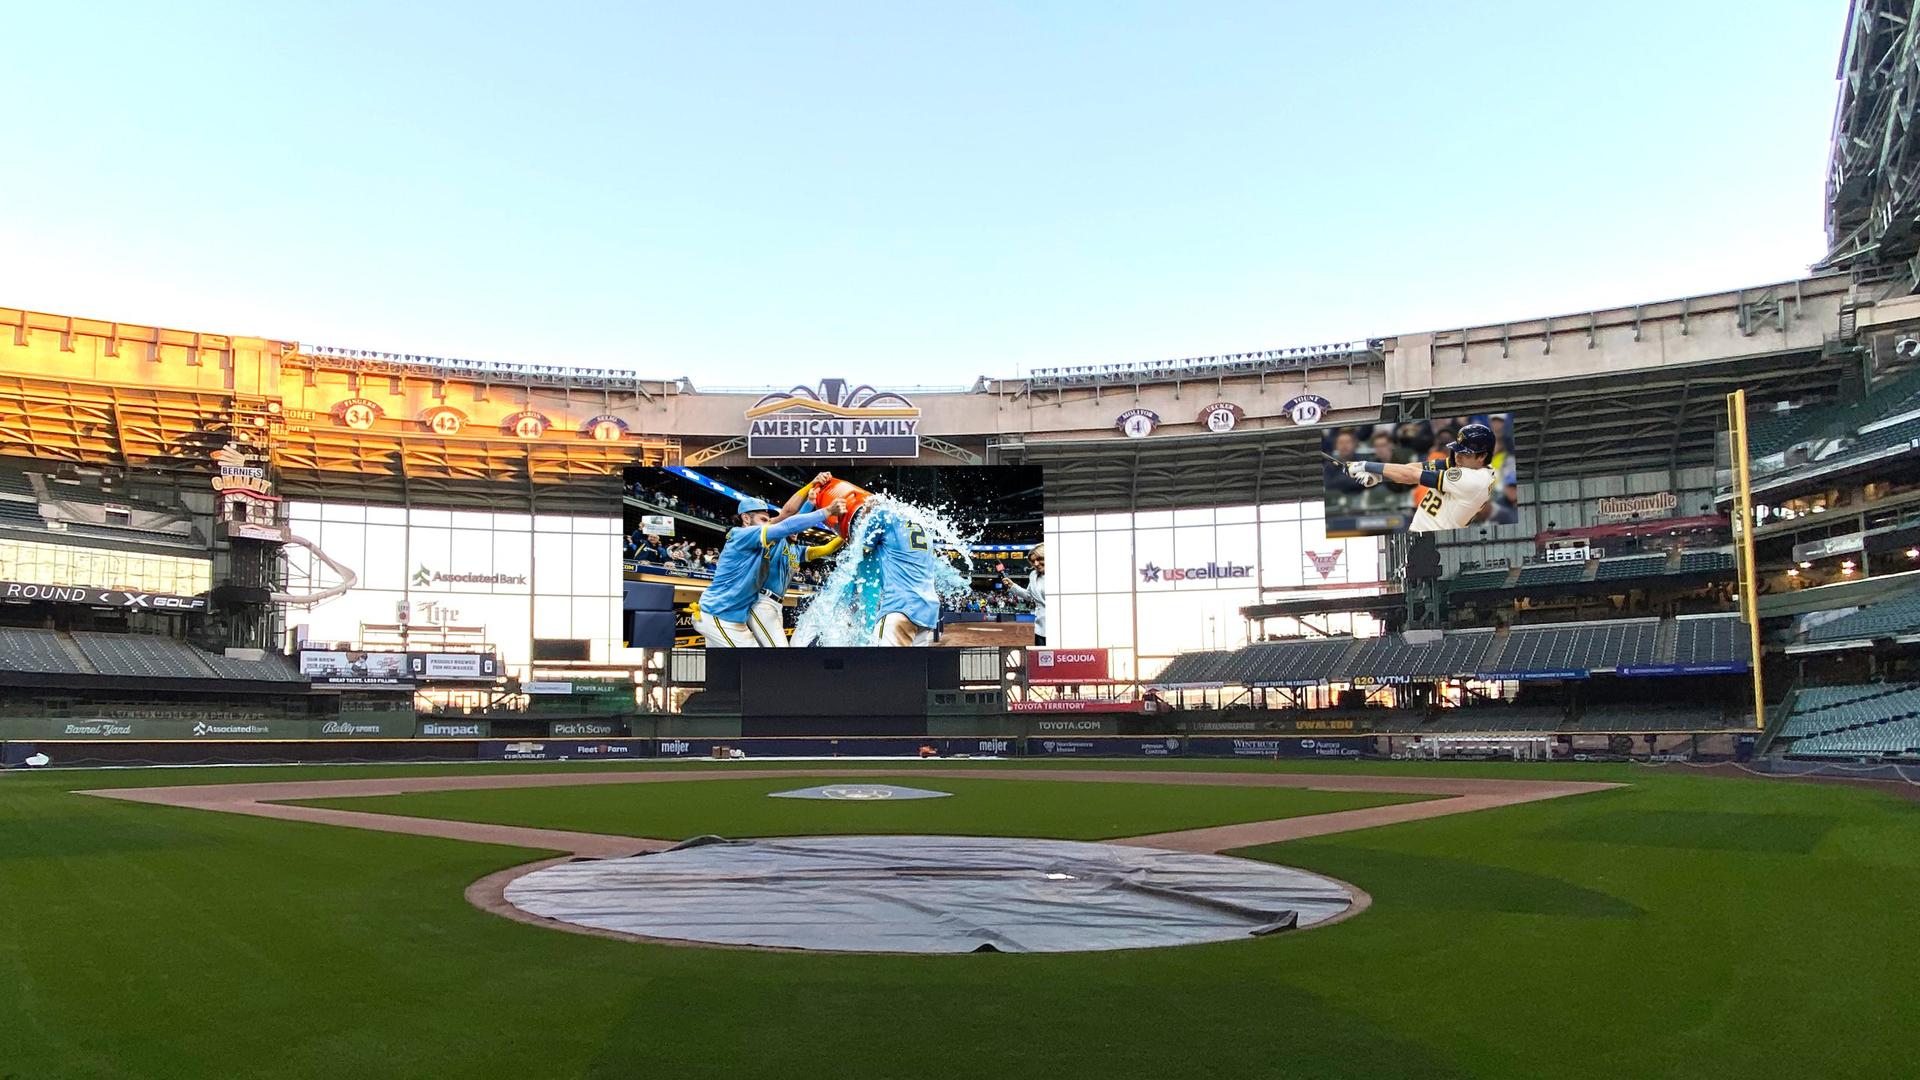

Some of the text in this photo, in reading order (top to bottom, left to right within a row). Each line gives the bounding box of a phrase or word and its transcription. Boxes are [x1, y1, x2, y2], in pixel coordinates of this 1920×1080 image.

[344, 399, 377, 409] FINGERS
[1294, 395, 1320, 404] YOUNT
[1206, 403, 1235, 412] UECKER
[1297, 405, 1316, 421] 19
[282, 409, 316, 421] GONE!
[350, 410, 371, 424] 34
[1122, 410, 1154, 419] MOLITOR
[1213, 412, 1229, 423] 50
[436, 417, 457, 431] 42
[520, 422, 540, 436] 44
[751, 420, 917, 436] AMERICAN FAMILY
[1132, 420, 1142, 433] 4
[605, 427, 611, 439] 1
[800, 438, 868, 453] FIELD
[222, 466, 263, 478] BERNIE'S
[211, 476, 272, 494] CHALET
[1420, 490, 1443, 517] 22
[1599, 491, 1677, 514] Johnsonville
[7, 584, 86, 601] ROUND
[153, 597, 205, 609] GOLF
[417, 600, 460, 625] Lite
[1056, 654, 1096, 662] SEQUOIA
[1354, 676, 1375, 686] 620
[1376, 675, 1411, 685] WTMJ
[1044, 702, 1085, 710] TERRITORY
[65, 723, 131, 736] Barrel Yard
[322, 721, 380, 735] Bally SPORTS
[434, 723, 479, 736] impact
[586, 725, 611, 734] Save
[1038, 721, 1101, 730] TOYOTA.COM
[662, 740, 690, 755] meijer
[979, 739, 1007, 753] meijer
[1233, 740, 1280, 748] WINTRUST
